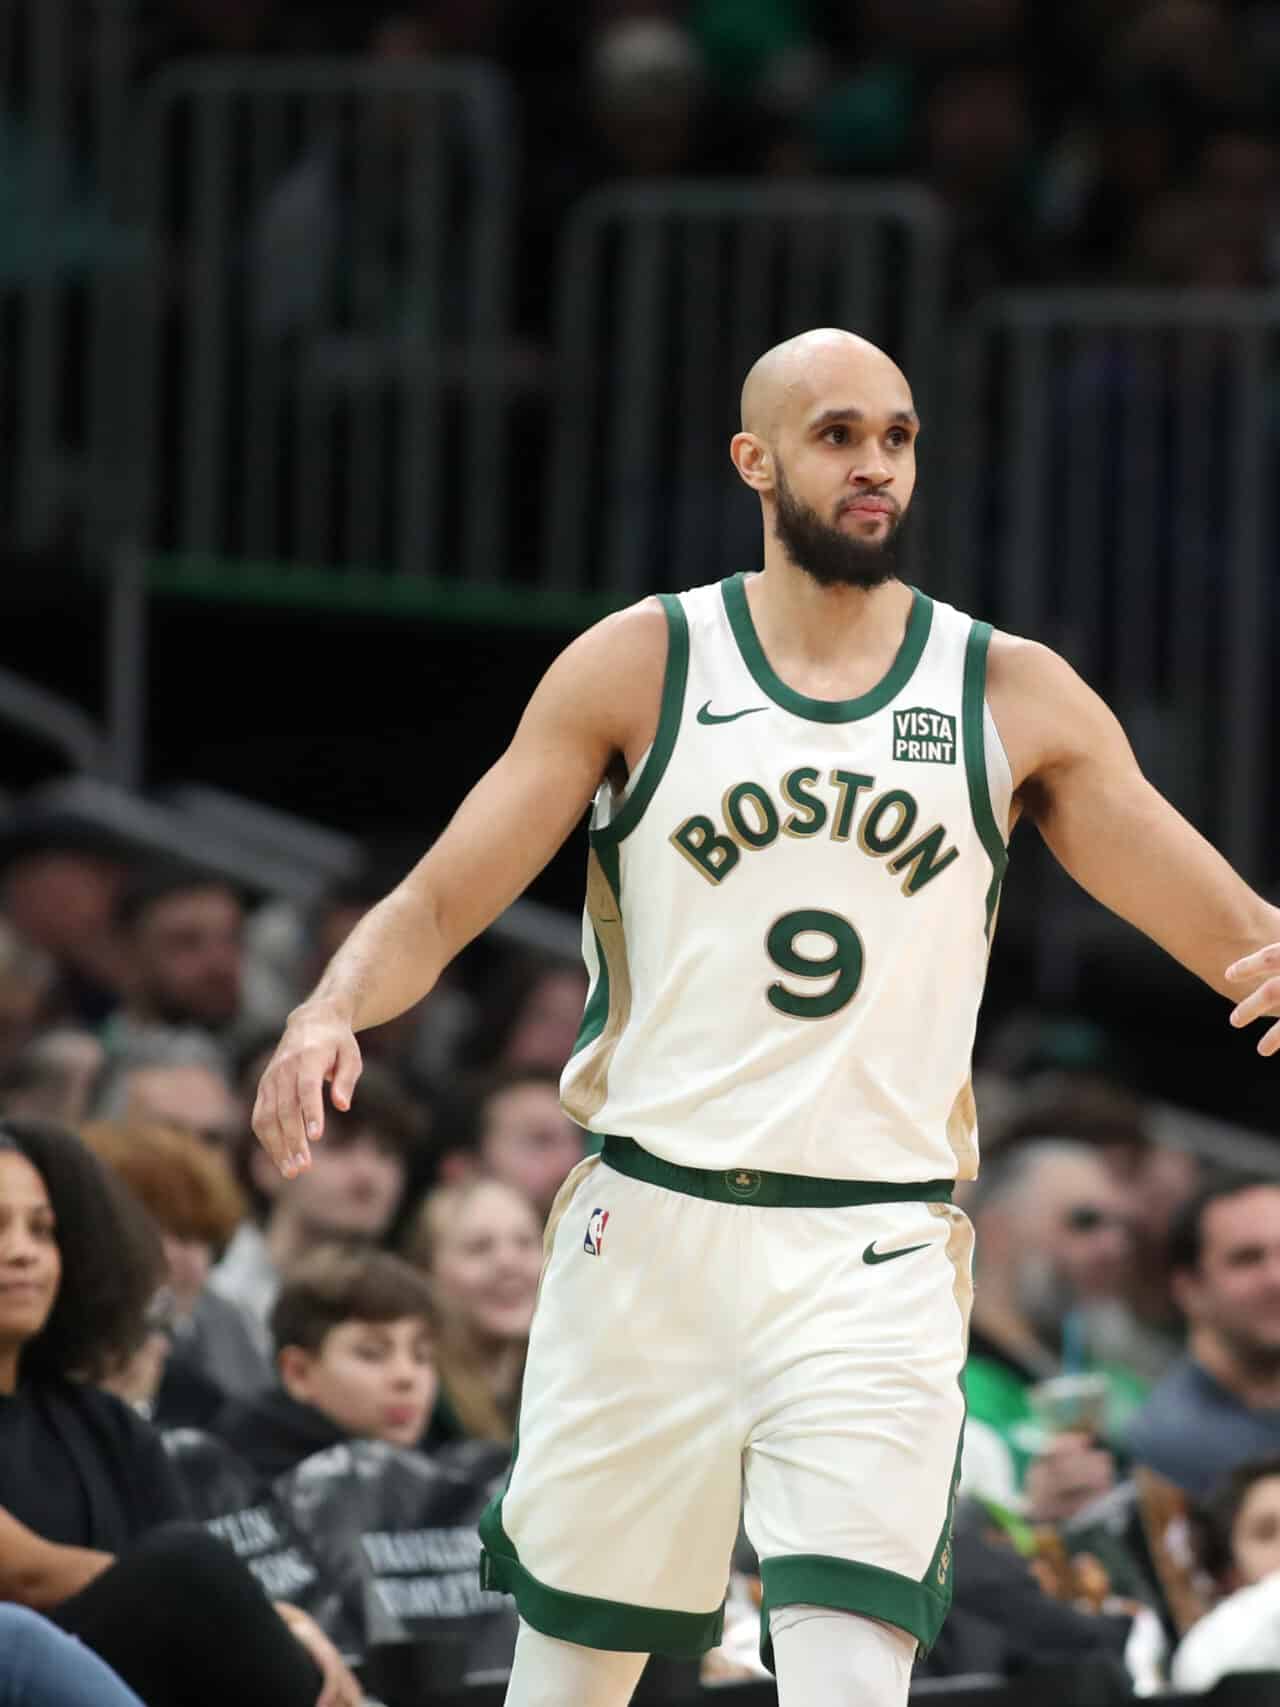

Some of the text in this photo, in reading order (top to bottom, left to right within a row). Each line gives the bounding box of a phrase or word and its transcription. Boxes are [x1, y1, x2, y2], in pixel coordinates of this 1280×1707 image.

[896, 711, 953, 741] VISTA
[896, 740, 953, 761] PRINT
[669, 766, 960, 898] BOSTON
[765, 908, 866, 1020] 9
